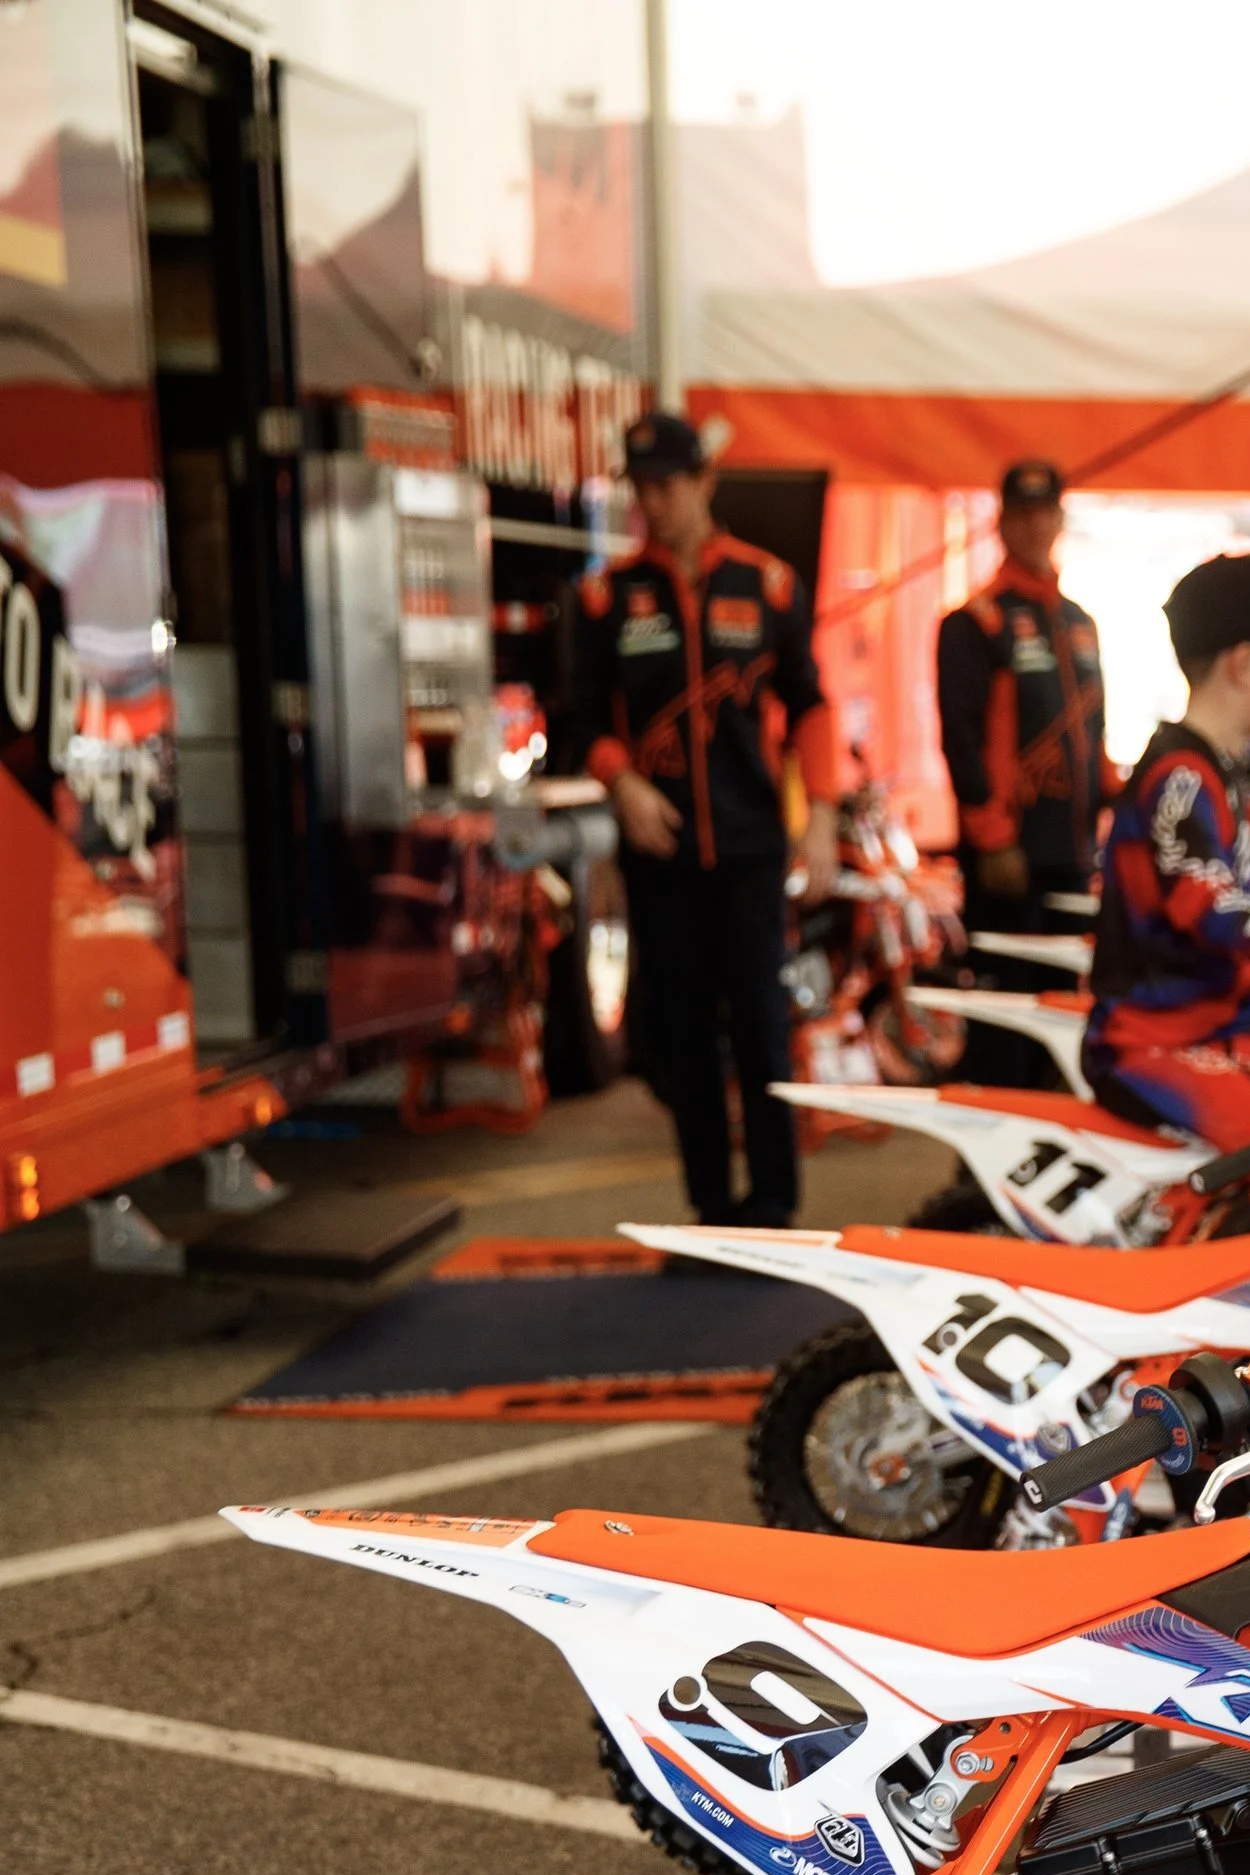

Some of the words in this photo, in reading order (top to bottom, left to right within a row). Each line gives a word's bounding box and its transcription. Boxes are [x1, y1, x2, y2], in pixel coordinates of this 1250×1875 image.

[1008, 1137, 1108, 1216] 11
[922, 1294, 1071, 1405] 10
[350, 1544, 479, 1577] DUNLOP
[658, 1641, 868, 1791] 9
[691, 1791, 735, 1828] KTM.COM
